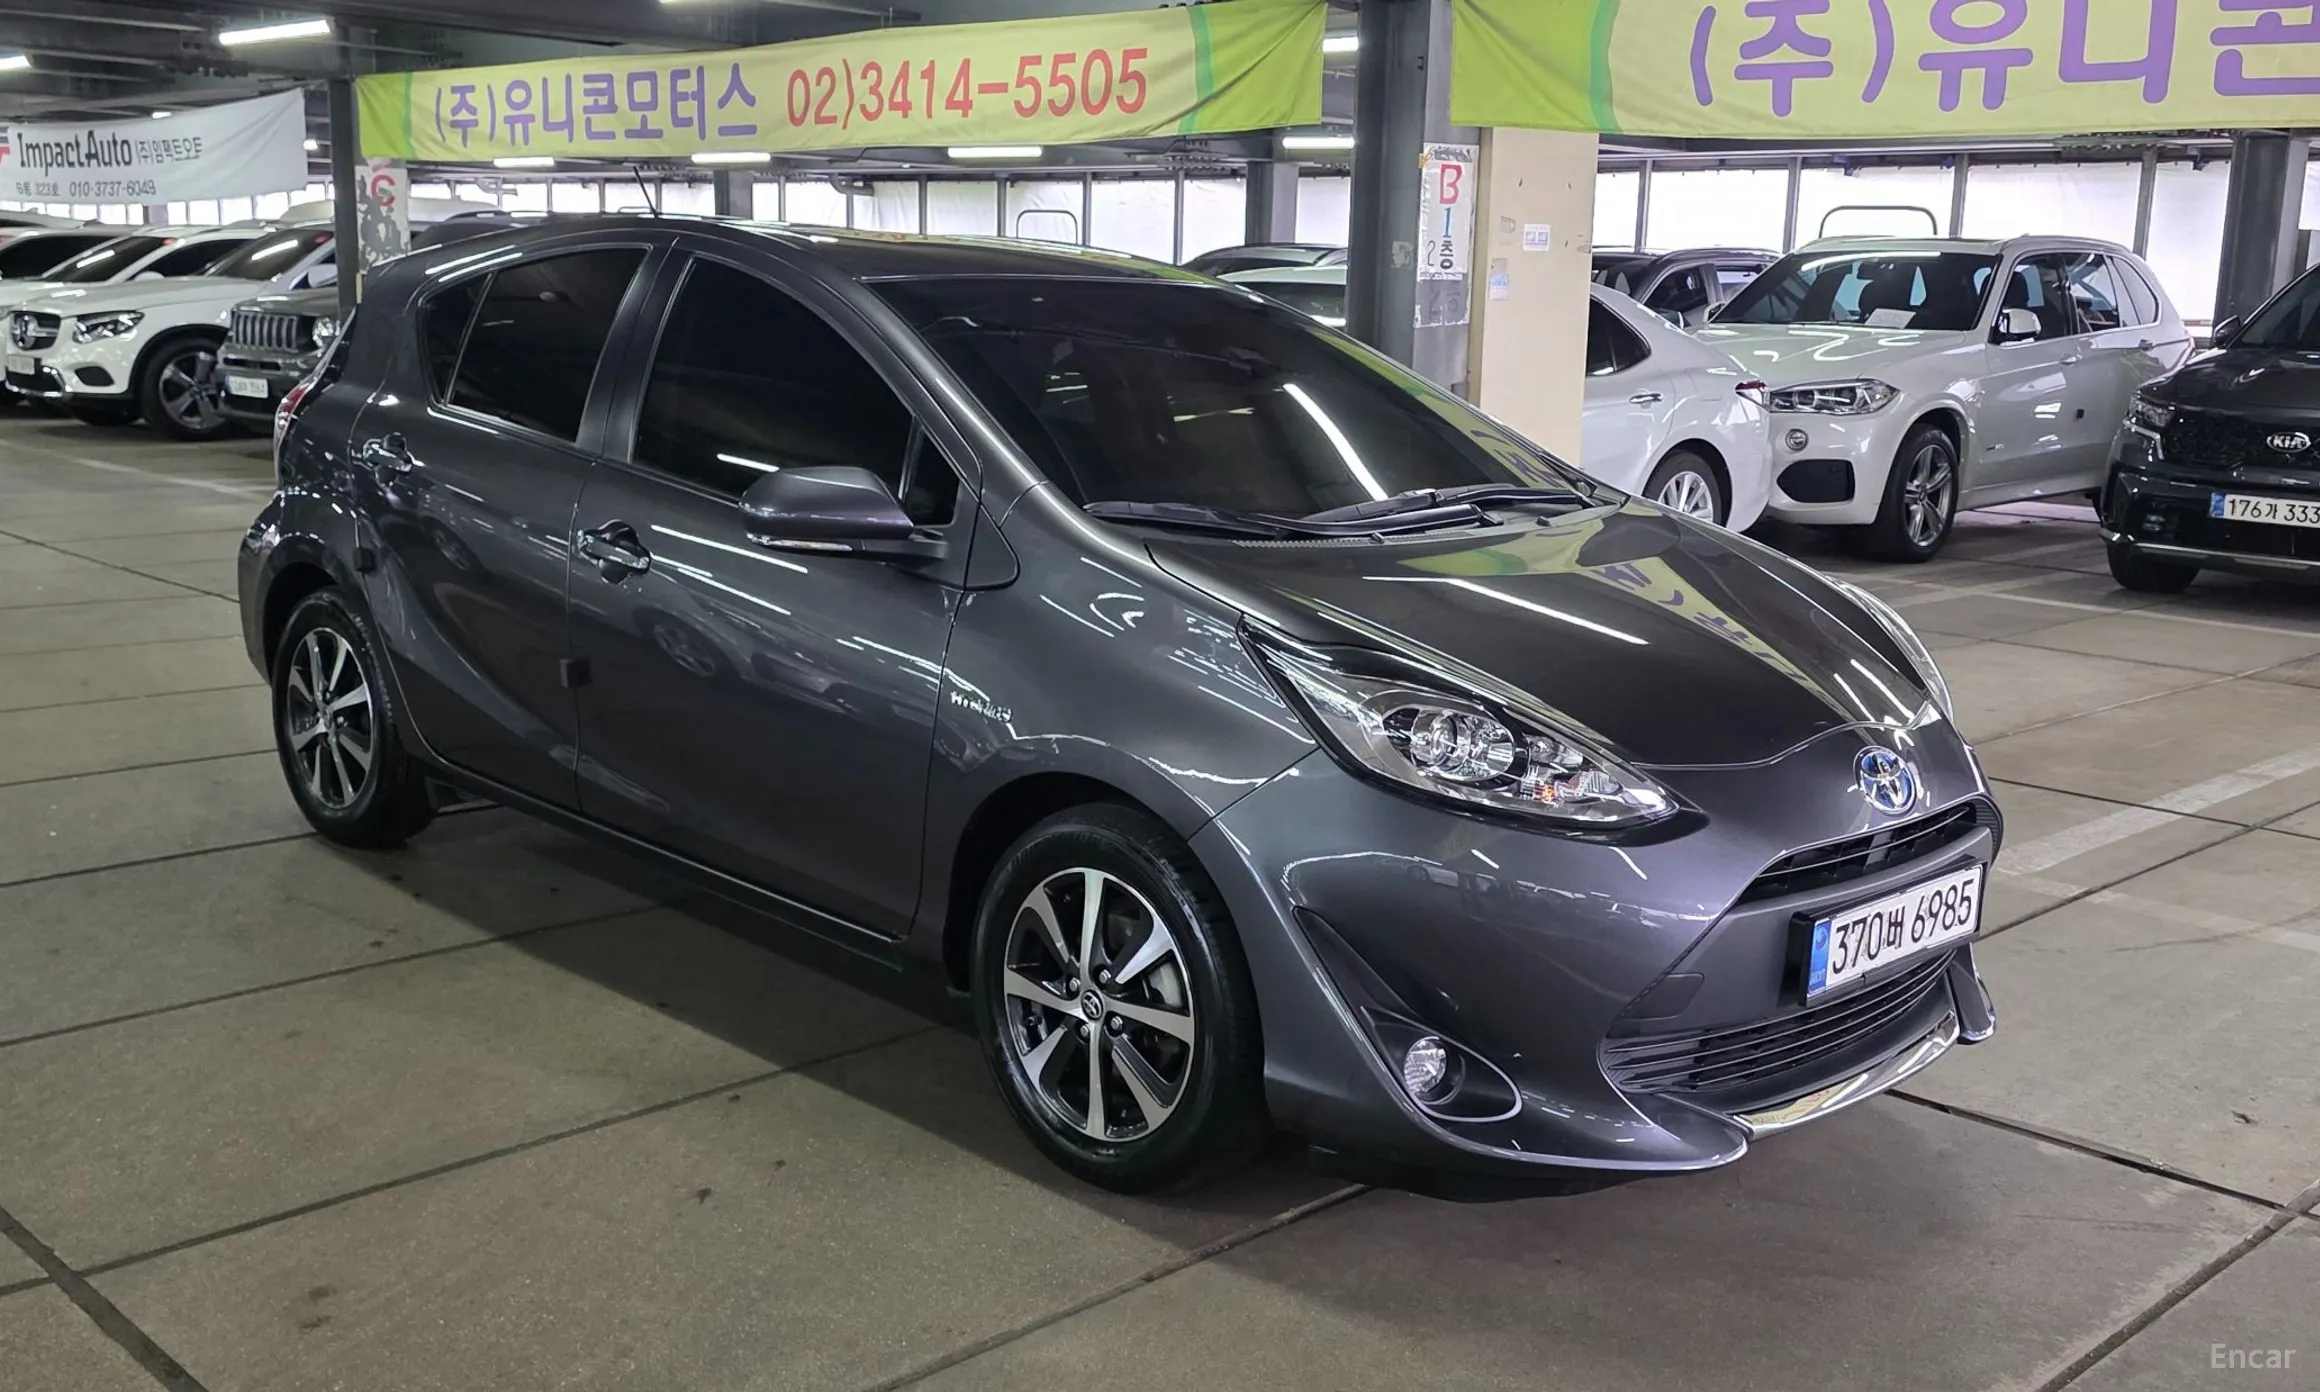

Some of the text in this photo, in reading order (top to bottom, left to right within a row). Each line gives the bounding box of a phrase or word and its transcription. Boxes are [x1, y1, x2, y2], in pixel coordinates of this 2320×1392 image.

[435, 48, 1148, 148] (주)유니콘모터스 02)3414-5505
[2273, 435, 2305, 449] KIA
[2228, 498, 2278, 520] 176가
[1832, 878, 1975, 975] 370버 6985
